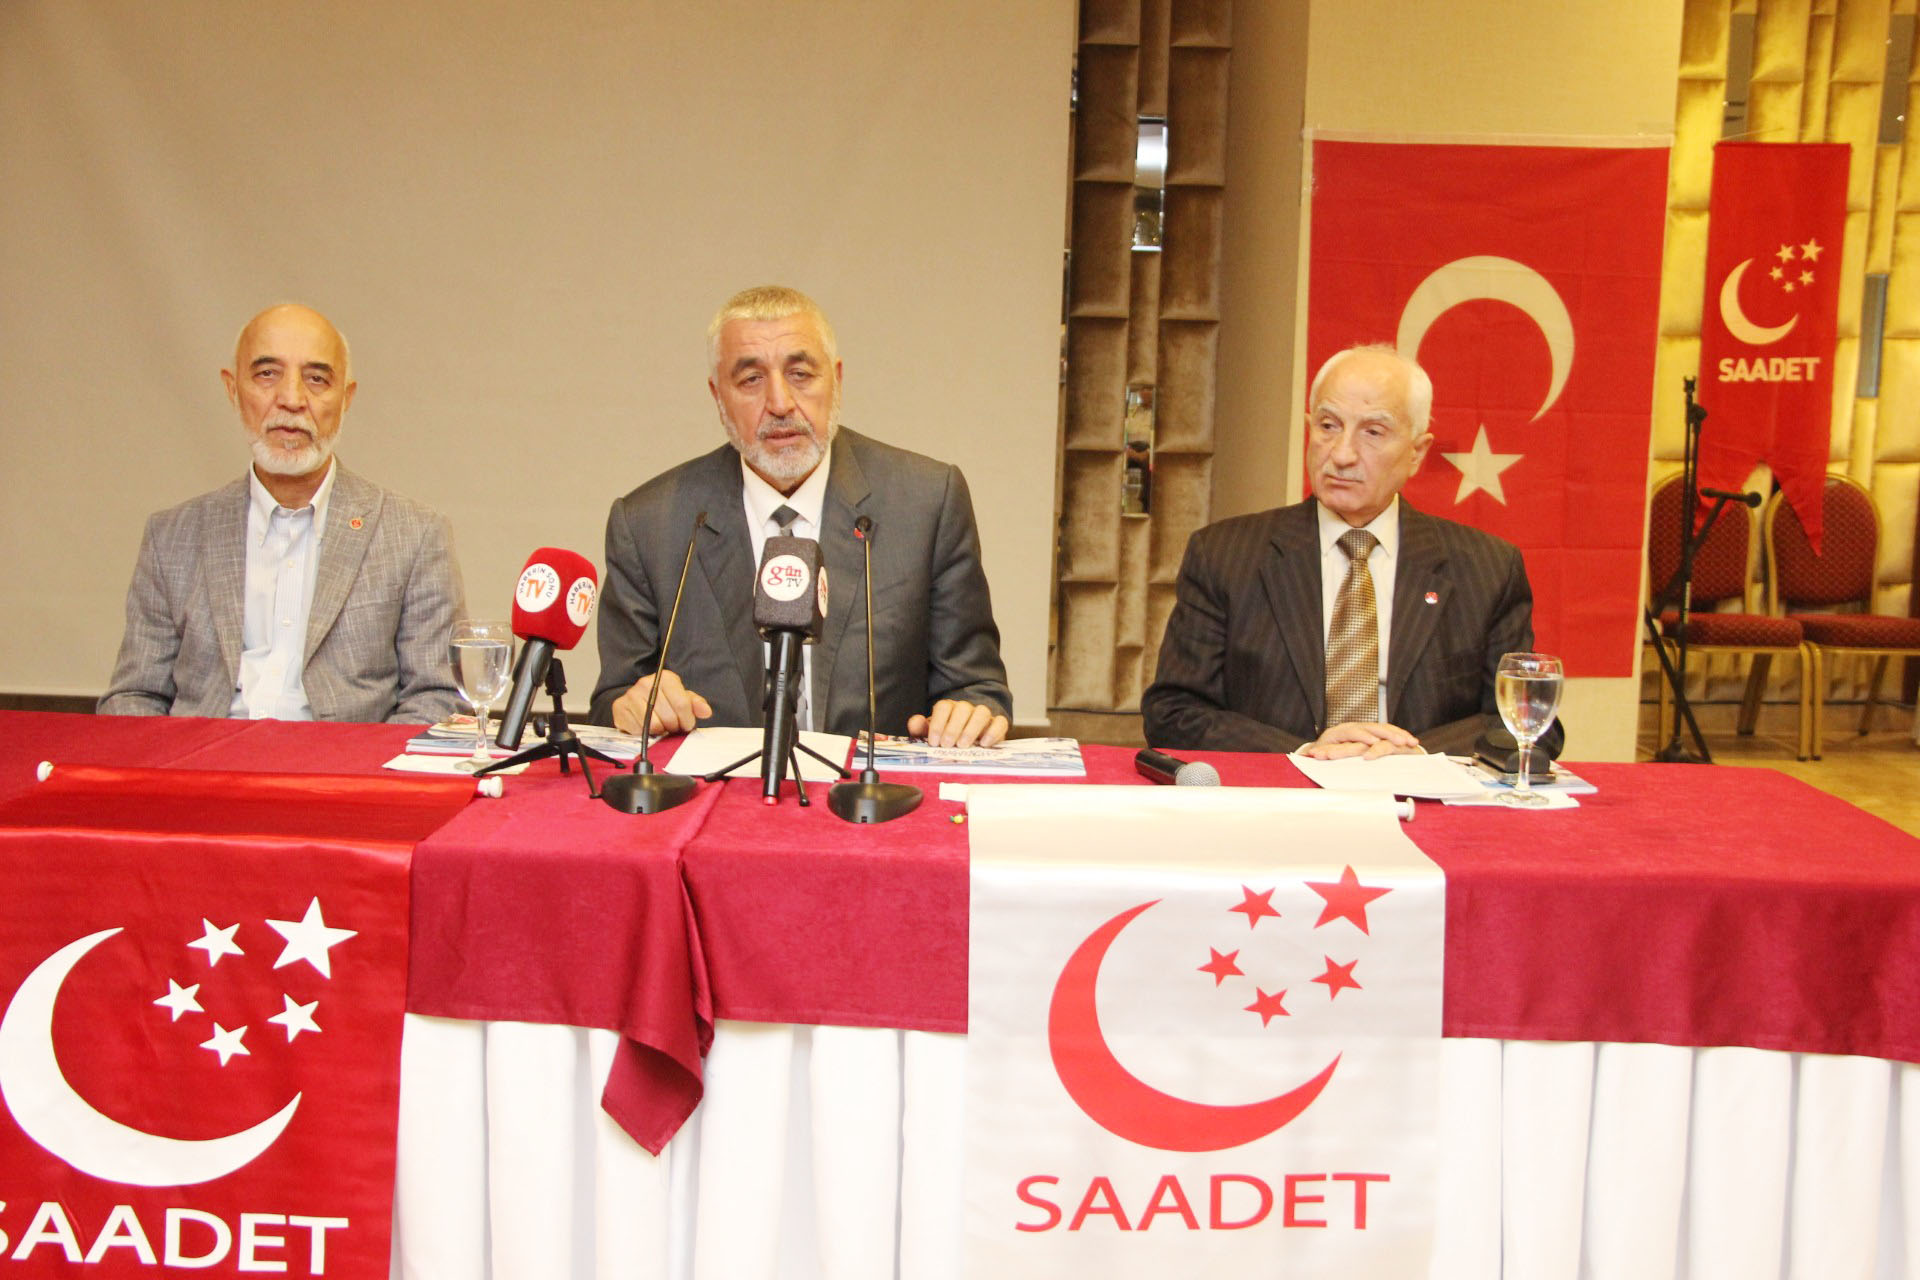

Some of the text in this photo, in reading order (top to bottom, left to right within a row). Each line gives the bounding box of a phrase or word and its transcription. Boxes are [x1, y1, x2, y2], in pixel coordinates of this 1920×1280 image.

[1718, 357, 1820, 382] SAADET
[526, 579, 546, 599] TV
[786, 577, 803, 588] TV
[577, 592, 592, 615] TV
[1014, 1172, 1391, 1233] SAADET
[0, 1201, 349, 1275] AADET
